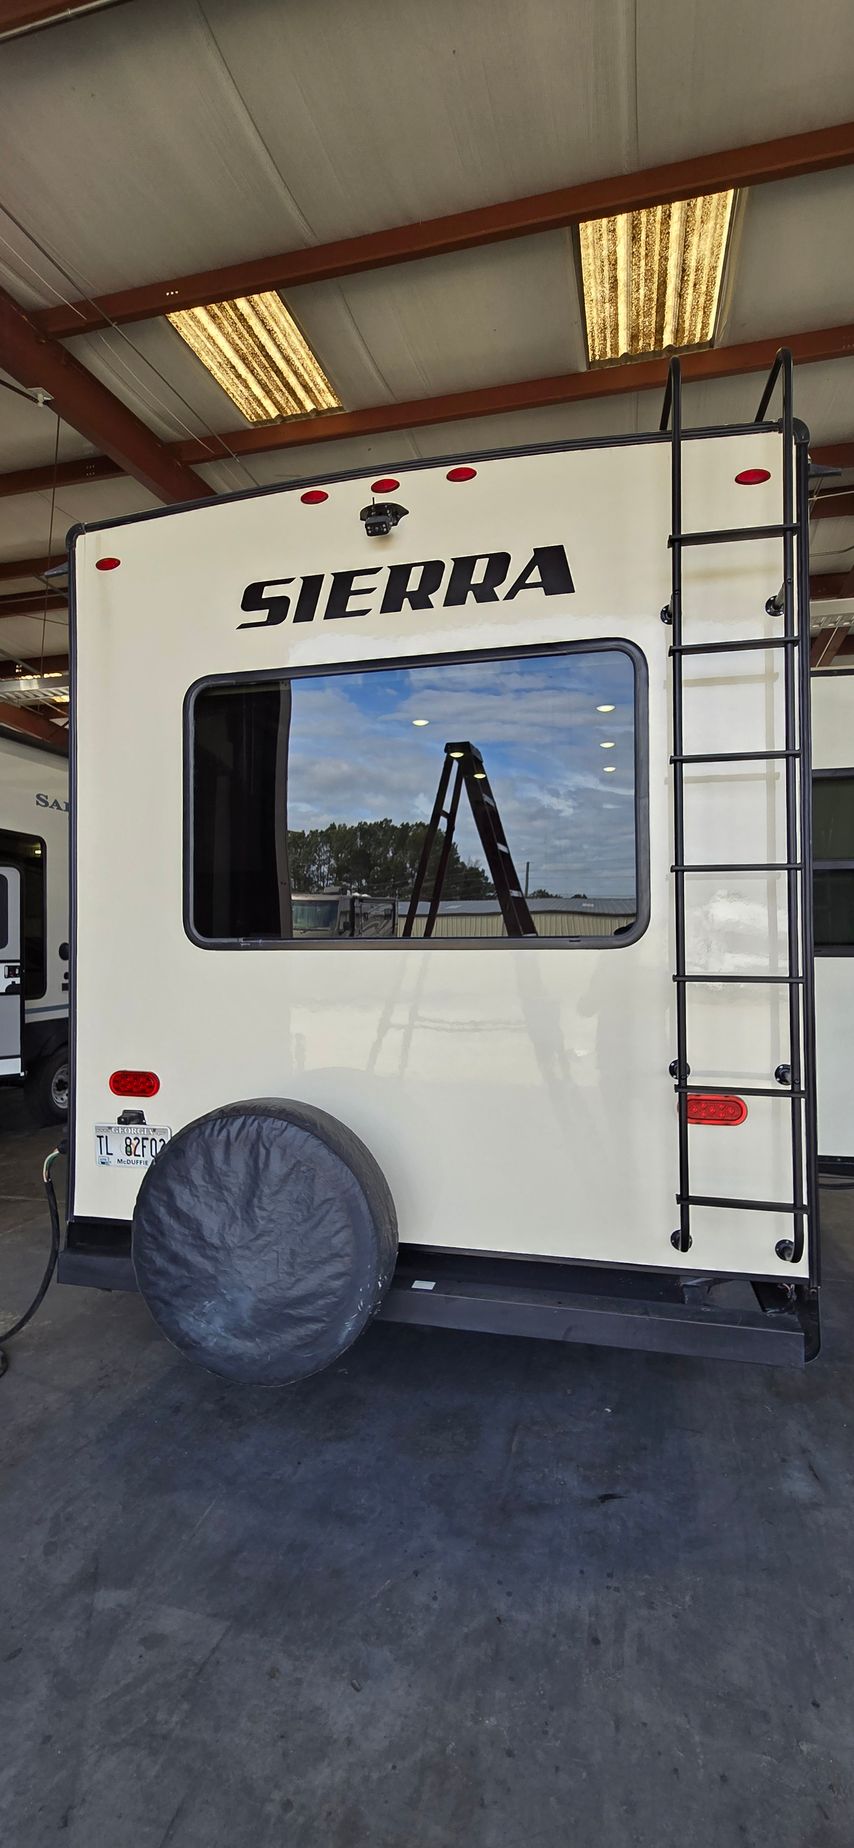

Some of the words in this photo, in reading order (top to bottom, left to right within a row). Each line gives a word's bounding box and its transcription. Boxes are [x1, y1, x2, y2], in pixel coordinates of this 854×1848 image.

[235, 544, 575, 630] SIERRA
[111, 1127, 153, 1135] GEORGIA
[97, 1135, 113, 1156] TL
